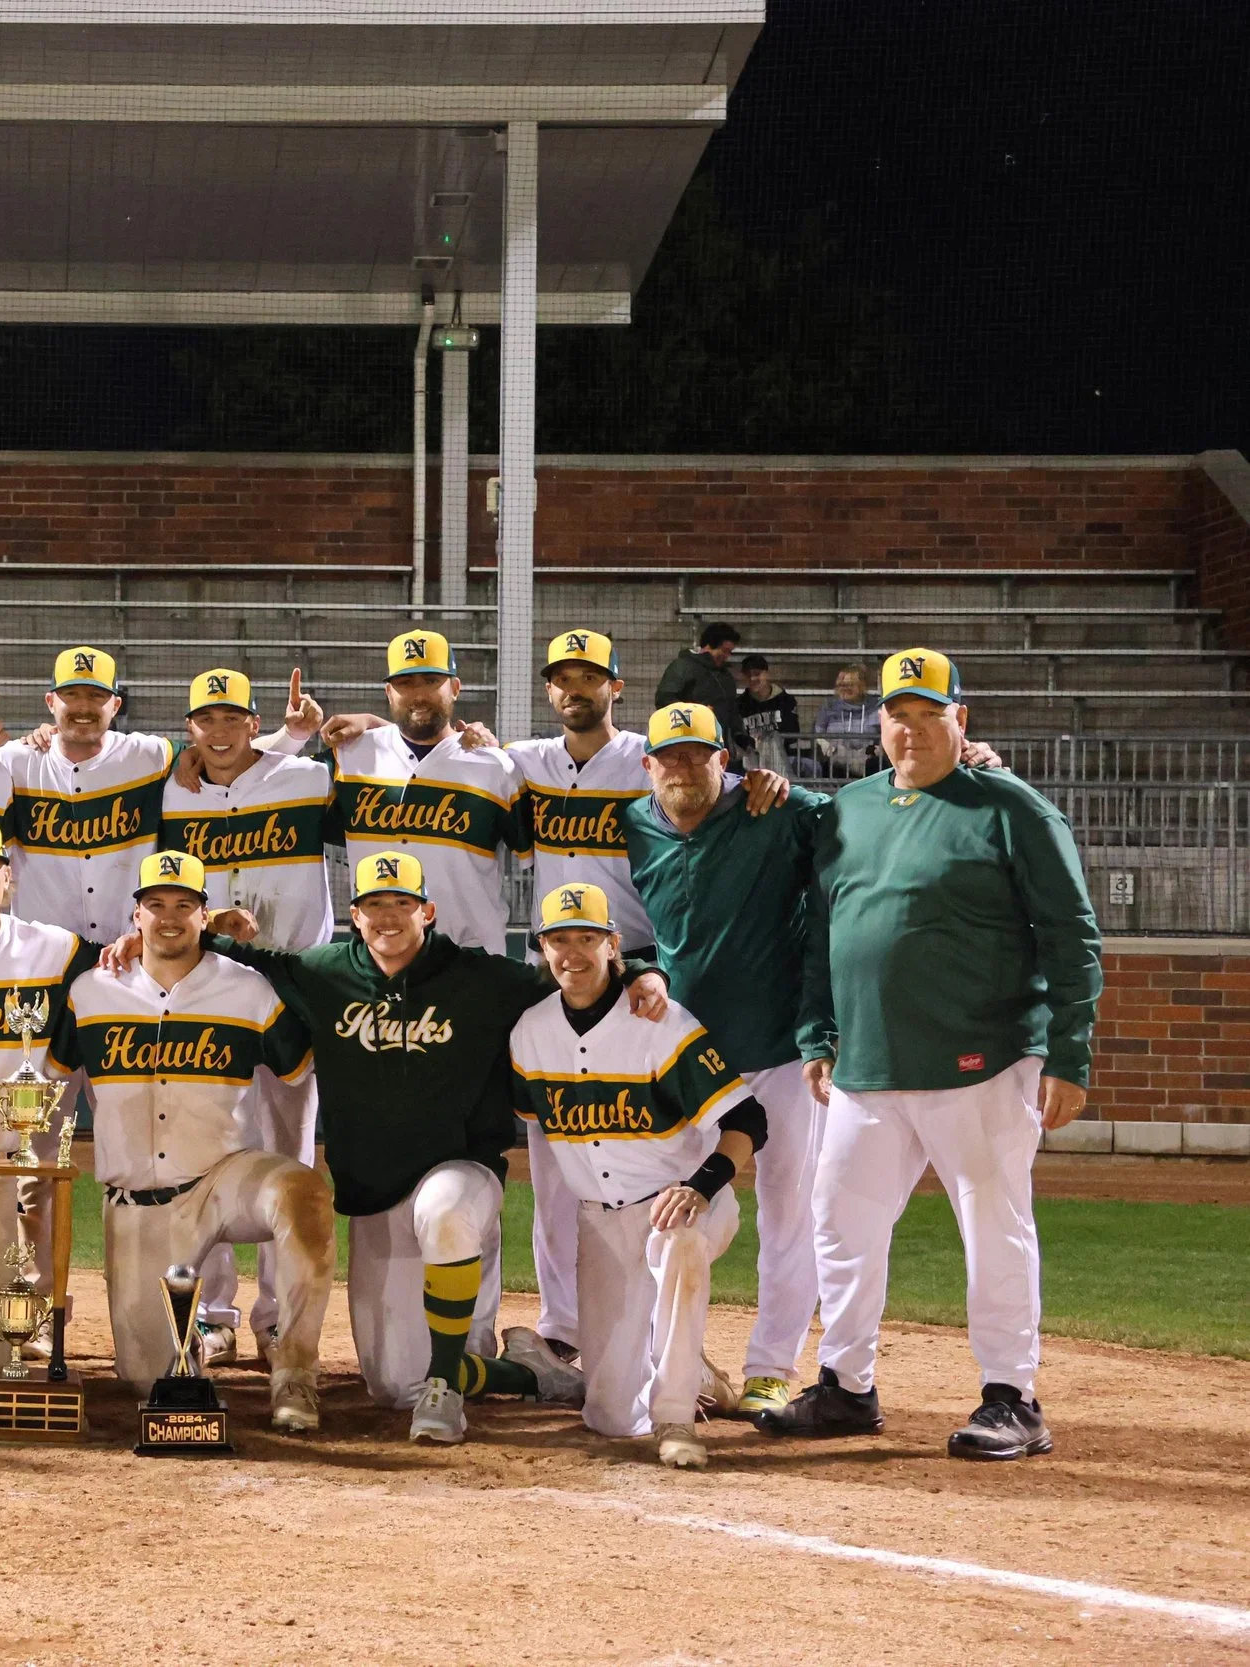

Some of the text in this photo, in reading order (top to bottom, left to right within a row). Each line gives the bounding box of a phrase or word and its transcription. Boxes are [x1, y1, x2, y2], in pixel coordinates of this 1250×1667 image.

[404, 638, 427, 661] N
[566, 633, 590, 653] N
[73, 652, 96, 673] N
[899, 656, 926, 681] N
[206, 674, 230, 696] N
[669, 708, 693, 730] N
[27, 796, 142, 845] Hawks
[351, 786, 471, 835] Hawks
[183, 812, 298, 861] Hawks
[158, 856, 184, 877] N
[375, 857, 401, 880] N
[560, 889, 585, 912] N
[335, 1001, 453, 1054] Hawks
[101, 1025, 233, 1071] Hawks
[698, 1048, 726, 1075] 12
[148, 1420, 219, 1442] CHAMPIONS
